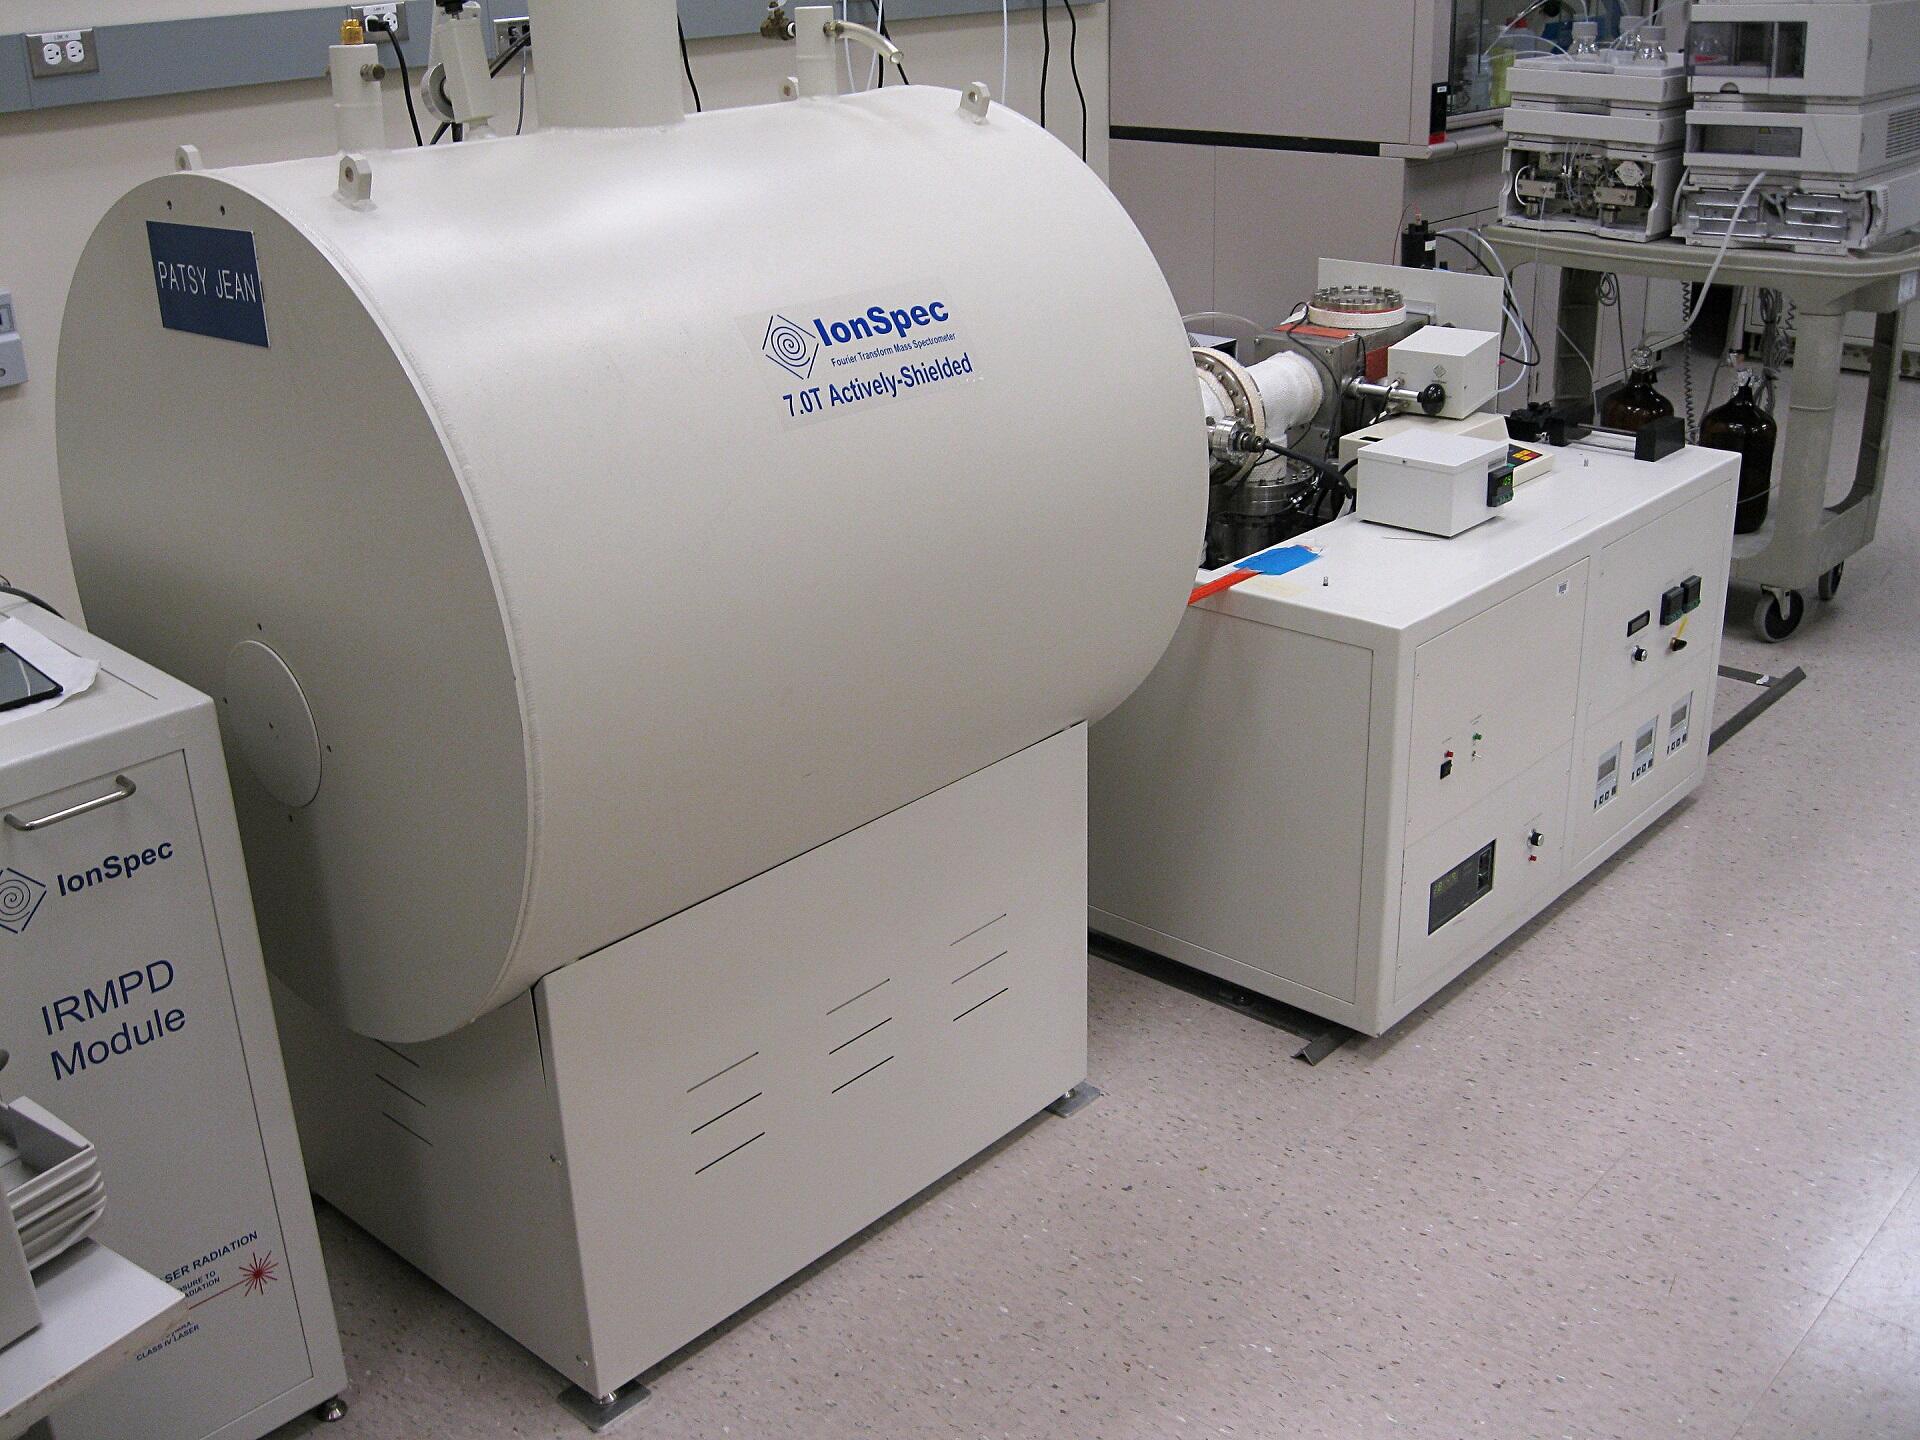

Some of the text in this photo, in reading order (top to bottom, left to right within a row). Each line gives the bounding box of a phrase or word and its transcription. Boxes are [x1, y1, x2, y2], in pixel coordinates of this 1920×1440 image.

[158, 261, 256, 303] PATSY JEAN
[813, 301, 949, 347] IonSpec
[831, 332, 956, 367] Fourier Transform Mass Spectrometer
[782, 352, 973, 417] 7.0T Actively-Shielded
[57, 841, 174, 897] IonSpec
[41, 959, 174, 1036] IRMPD
[50, 1008, 185, 1081] Module
[164, 1230, 258, 1284] SER RADIATION
[205, 1270, 216, 1280] TO
[136, 1343, 163, 1361] CLASS
[164, 1337, 172, 1347] IV
[173, 1324, 200, 1342] LASER
